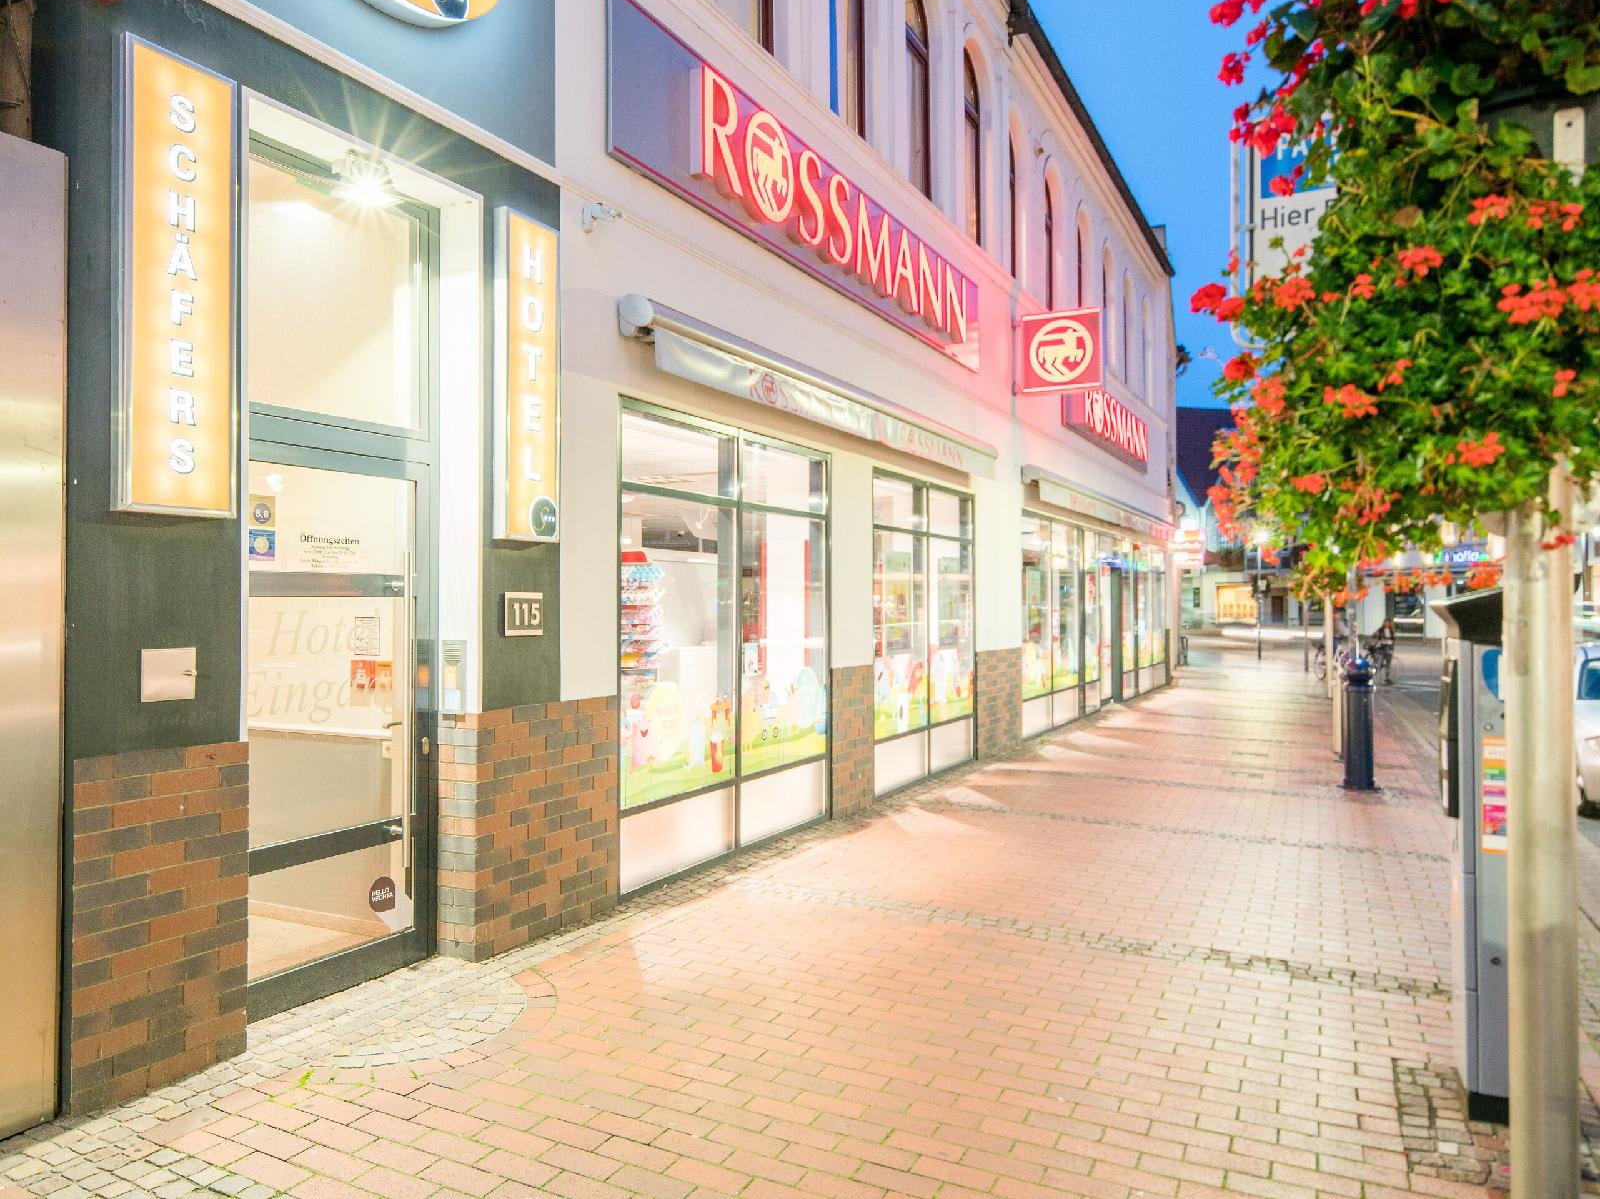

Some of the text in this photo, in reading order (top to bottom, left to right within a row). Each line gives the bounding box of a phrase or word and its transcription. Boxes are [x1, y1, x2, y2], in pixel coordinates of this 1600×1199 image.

[702, 64, 967, 344] ROSSMANN
[1260, 205, 1316, 230] Hier
[167, 92, 198, 475] SCHÄFERS
[522, 243, 544, 482] HOTEL
[1084, 390, 1149, 464] ROSSMANN
[512, 602, 541, 627] 115
